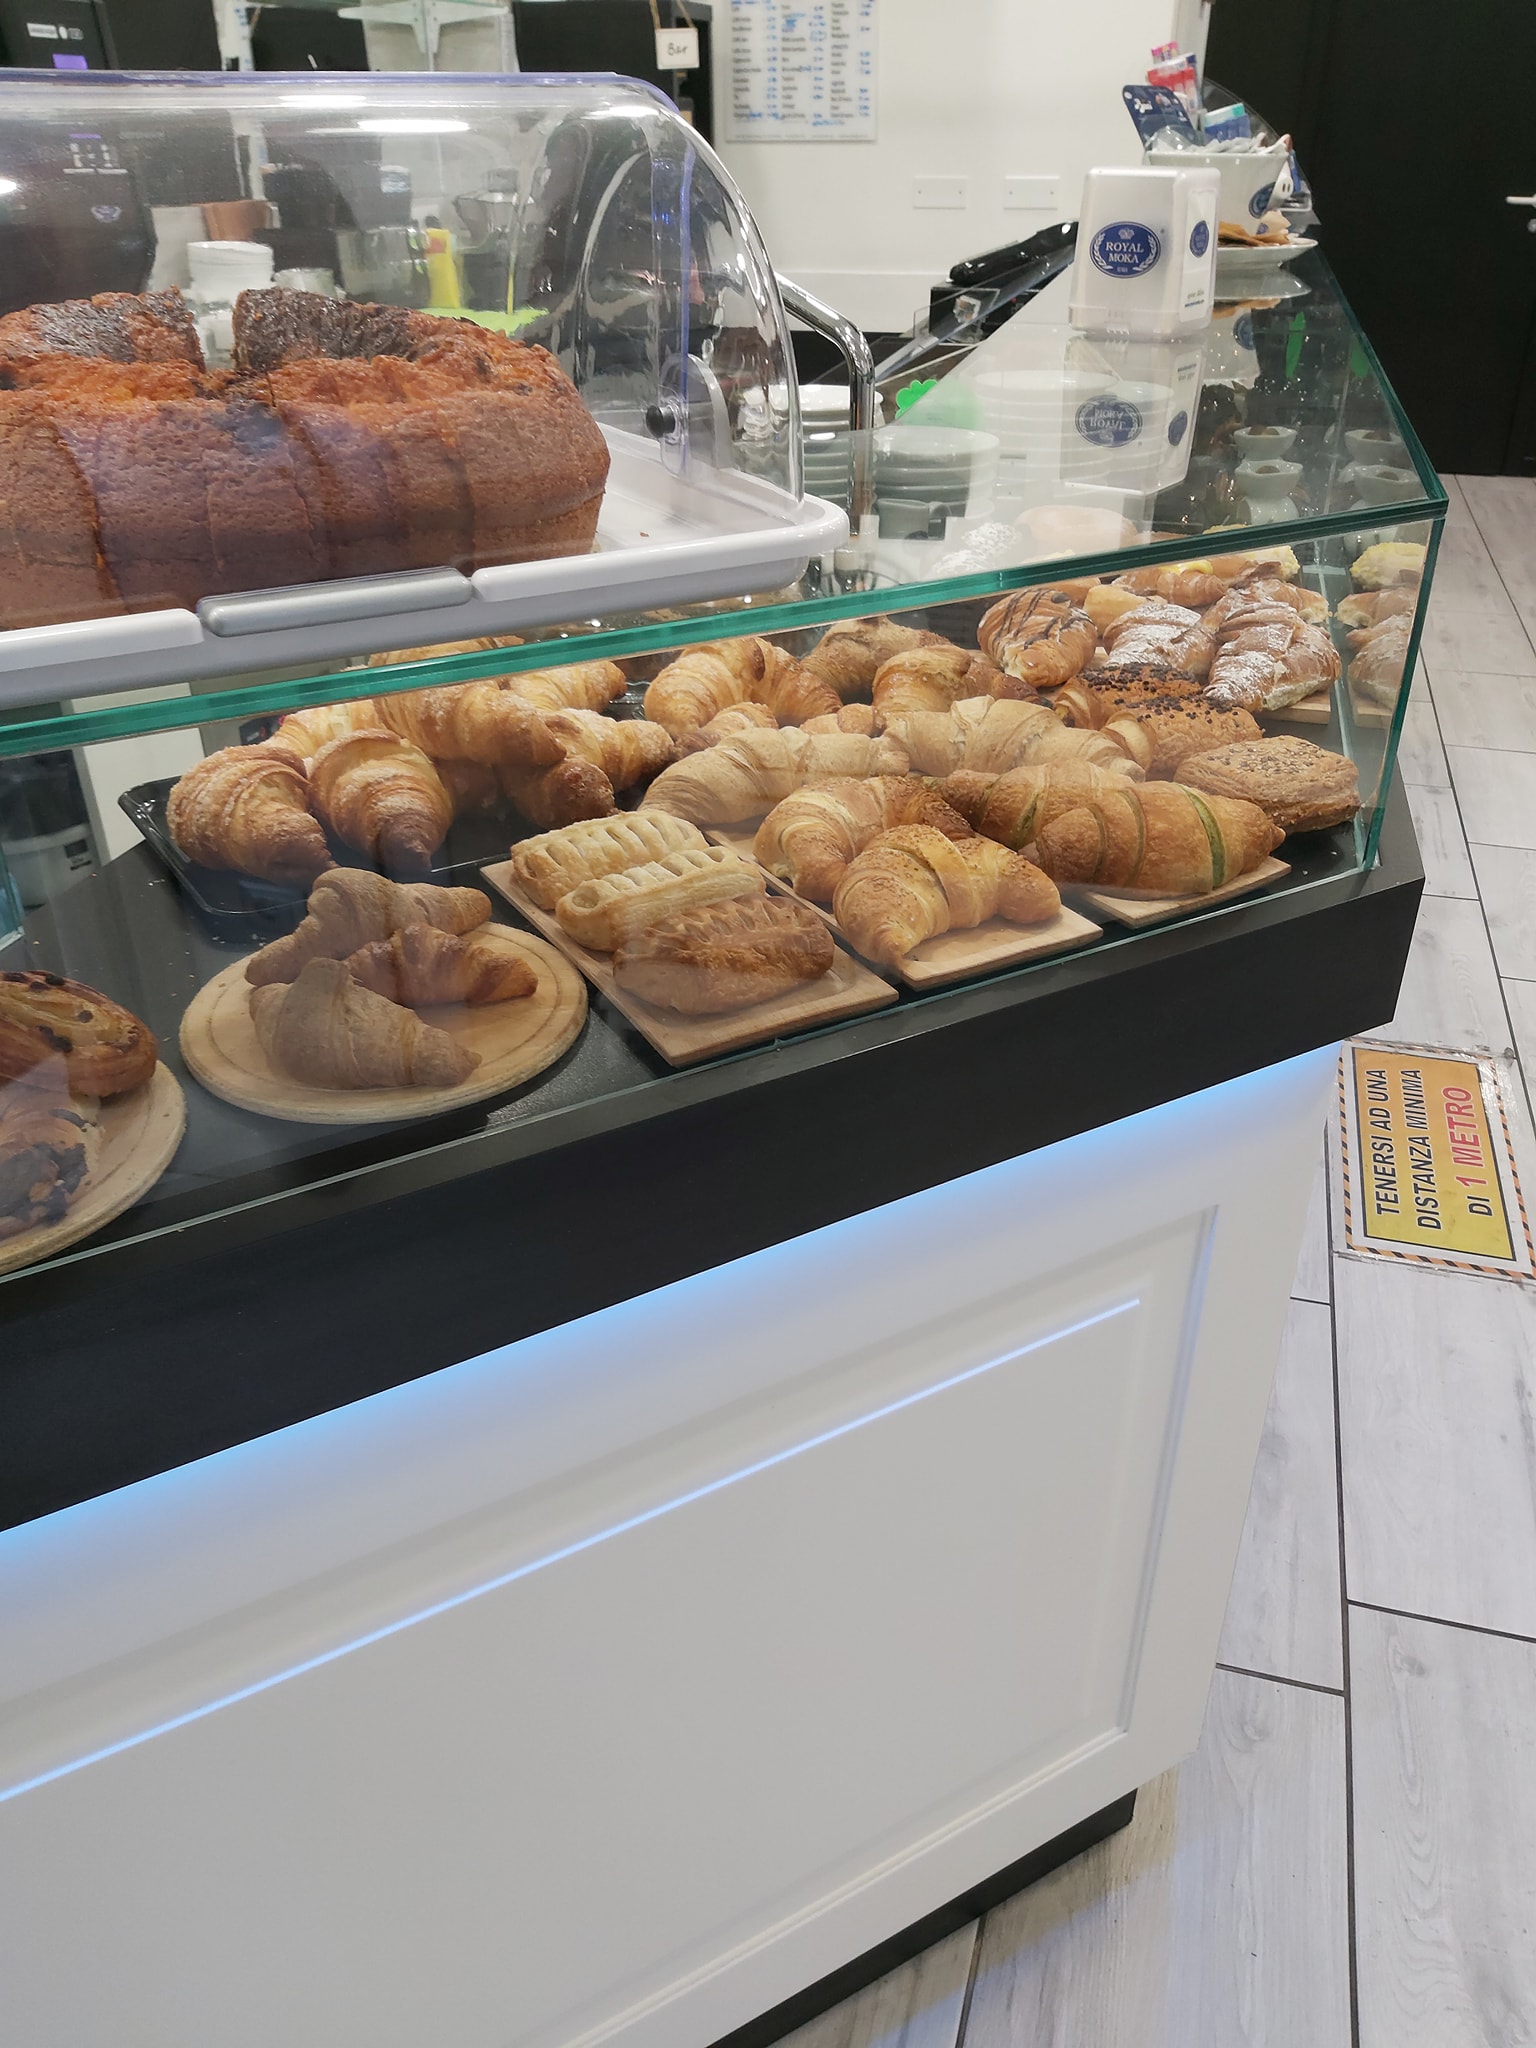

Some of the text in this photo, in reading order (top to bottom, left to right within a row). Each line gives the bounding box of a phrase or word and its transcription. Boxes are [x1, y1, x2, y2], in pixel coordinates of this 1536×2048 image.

[667, 42, 688, 56] Bar
[1105, 241, 1144, 253] ROYAL
[1108, 253, 1139, 264] MOKA
[1366, 1070, 1400, 1215] TENERSI AD UNA
[1400, 1069, 1442, 1230] DISTANZA MINIMA
[1443, 1087, 1493, 1217] DI 1 METRO
